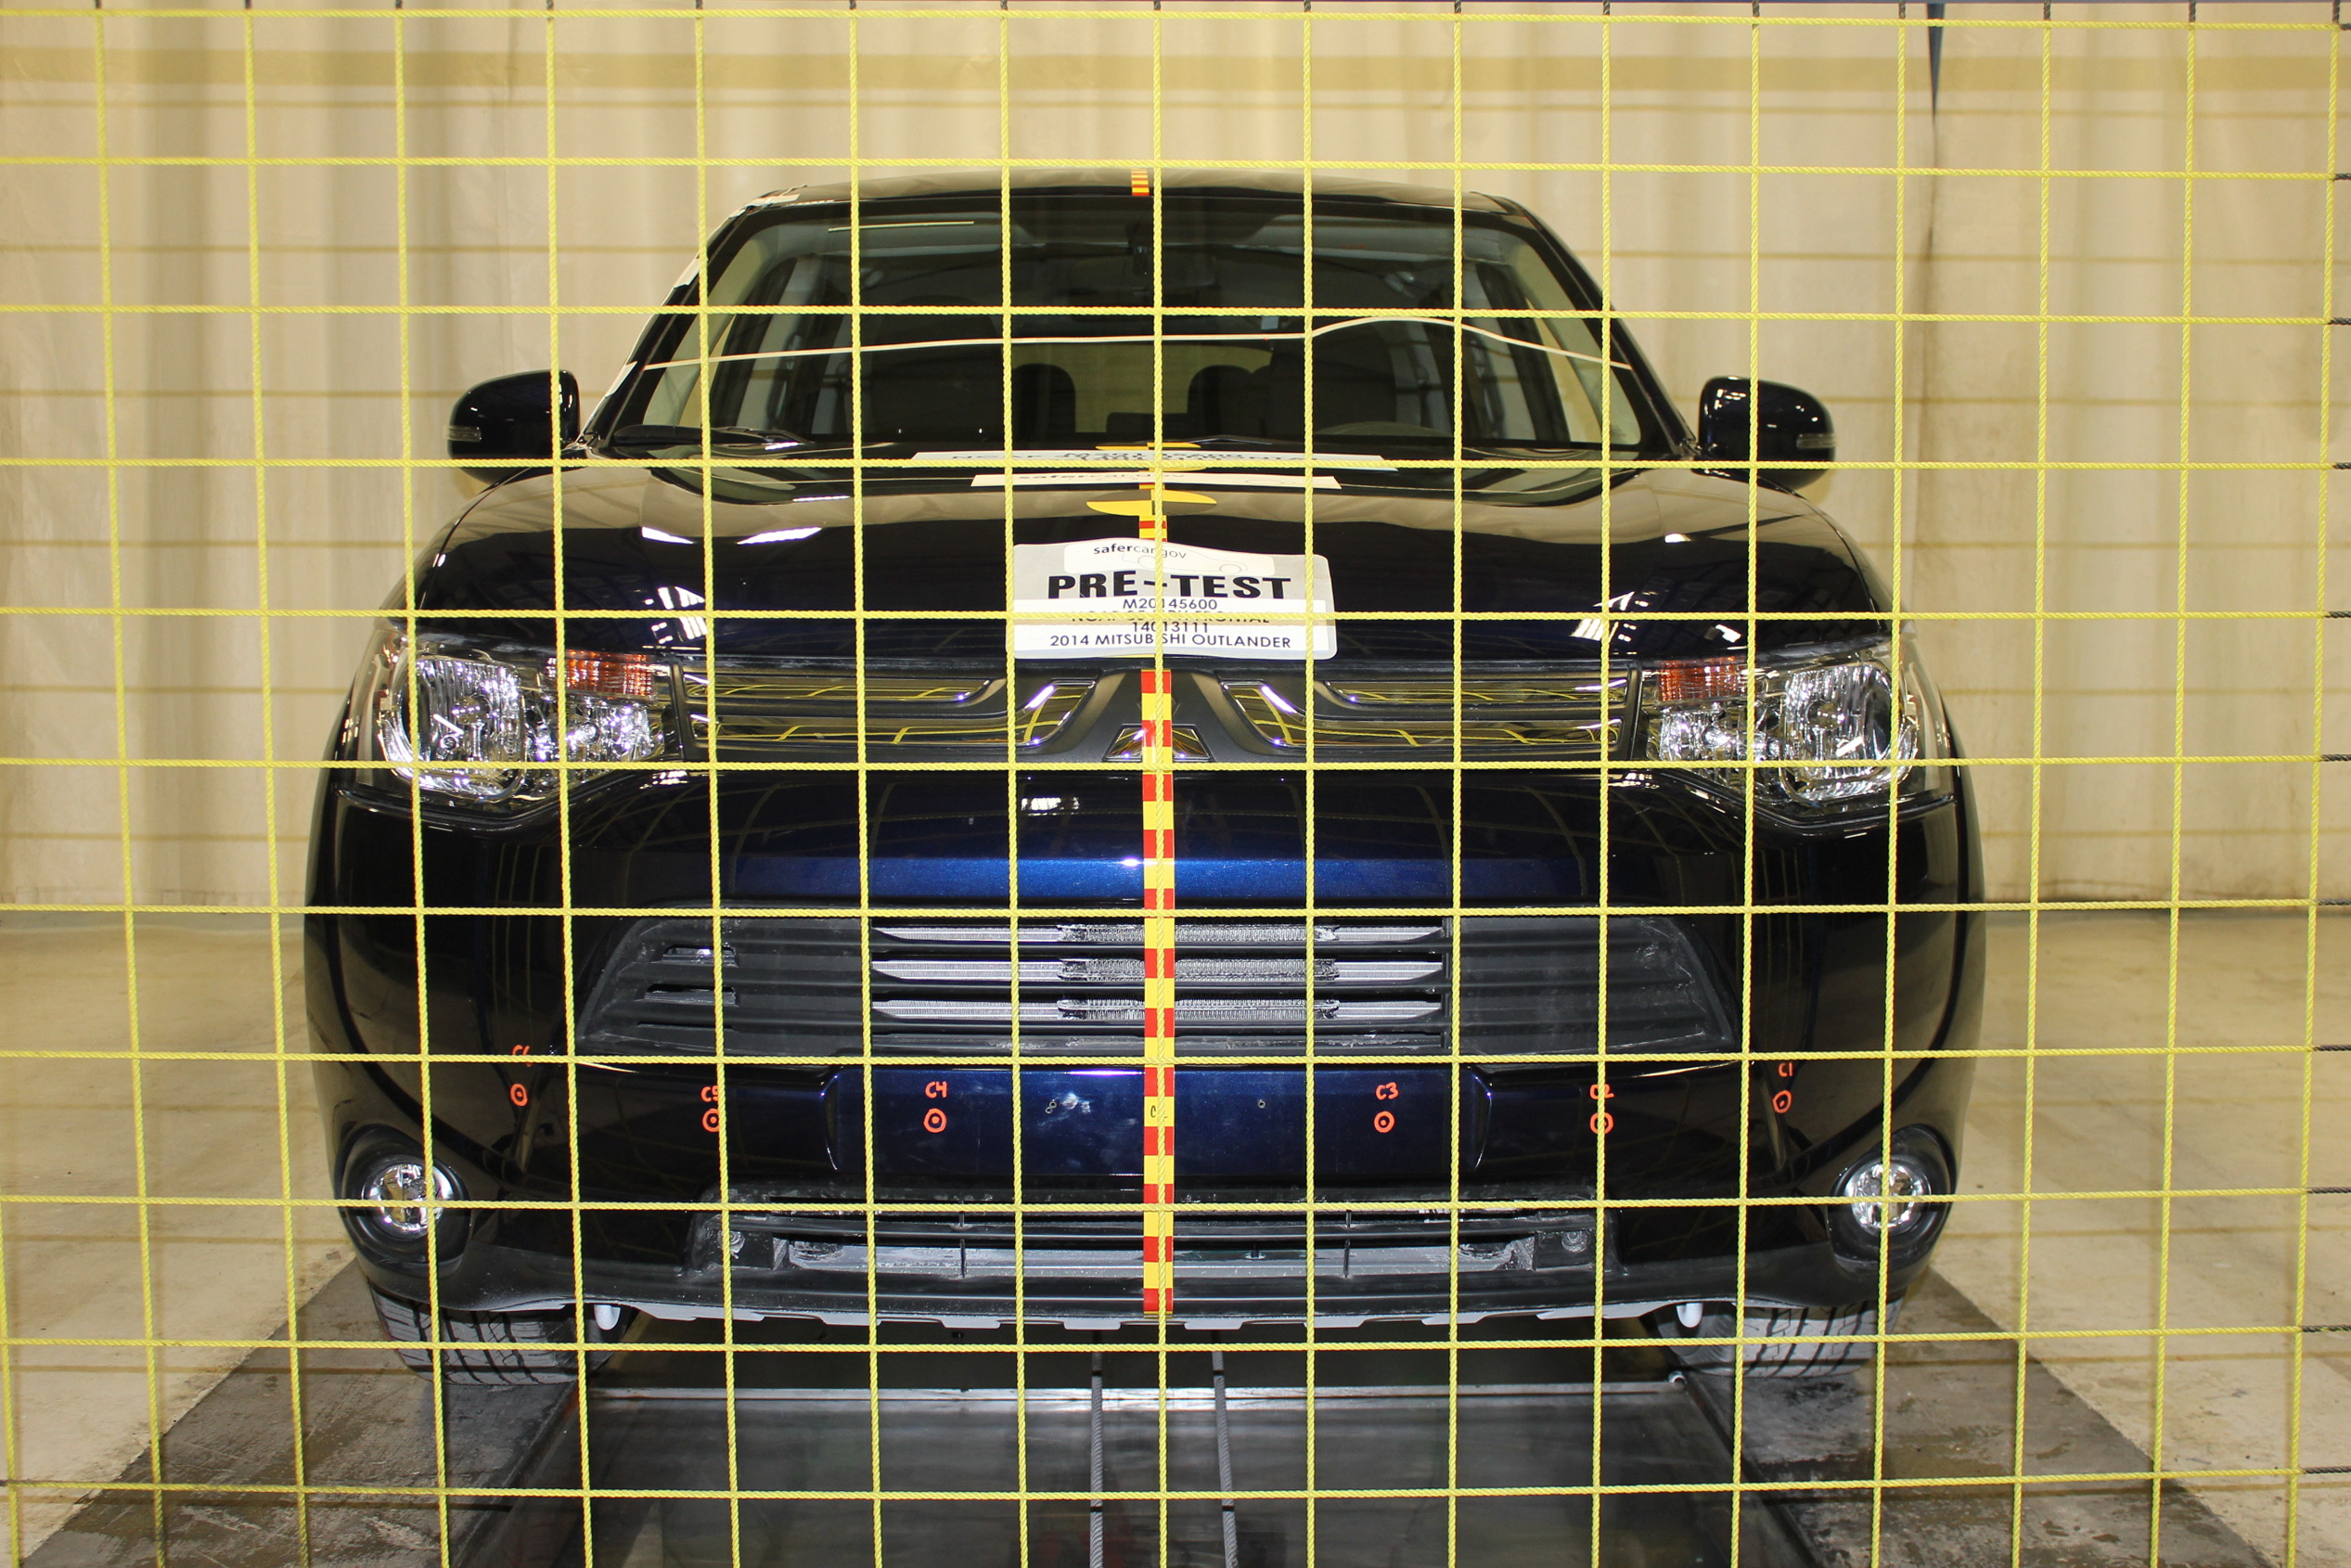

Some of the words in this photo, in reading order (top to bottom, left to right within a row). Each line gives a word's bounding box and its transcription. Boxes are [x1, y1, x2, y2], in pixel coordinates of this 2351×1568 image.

[1093, 543, 1188, 559] safercargov
[1047, 570, 1291, 600] PRE-TEST
[1049, 635, 1090, 647] 2014
[1095, 633, 1187, 646] MITSUBSHI
[1191, 634, 1291, 649] OUTLANDER
[925, 1080, 947, 1099] C4
[1375, 1081, 1399, 1100] C3
[1589, 1083, 1614, 1100] C2
